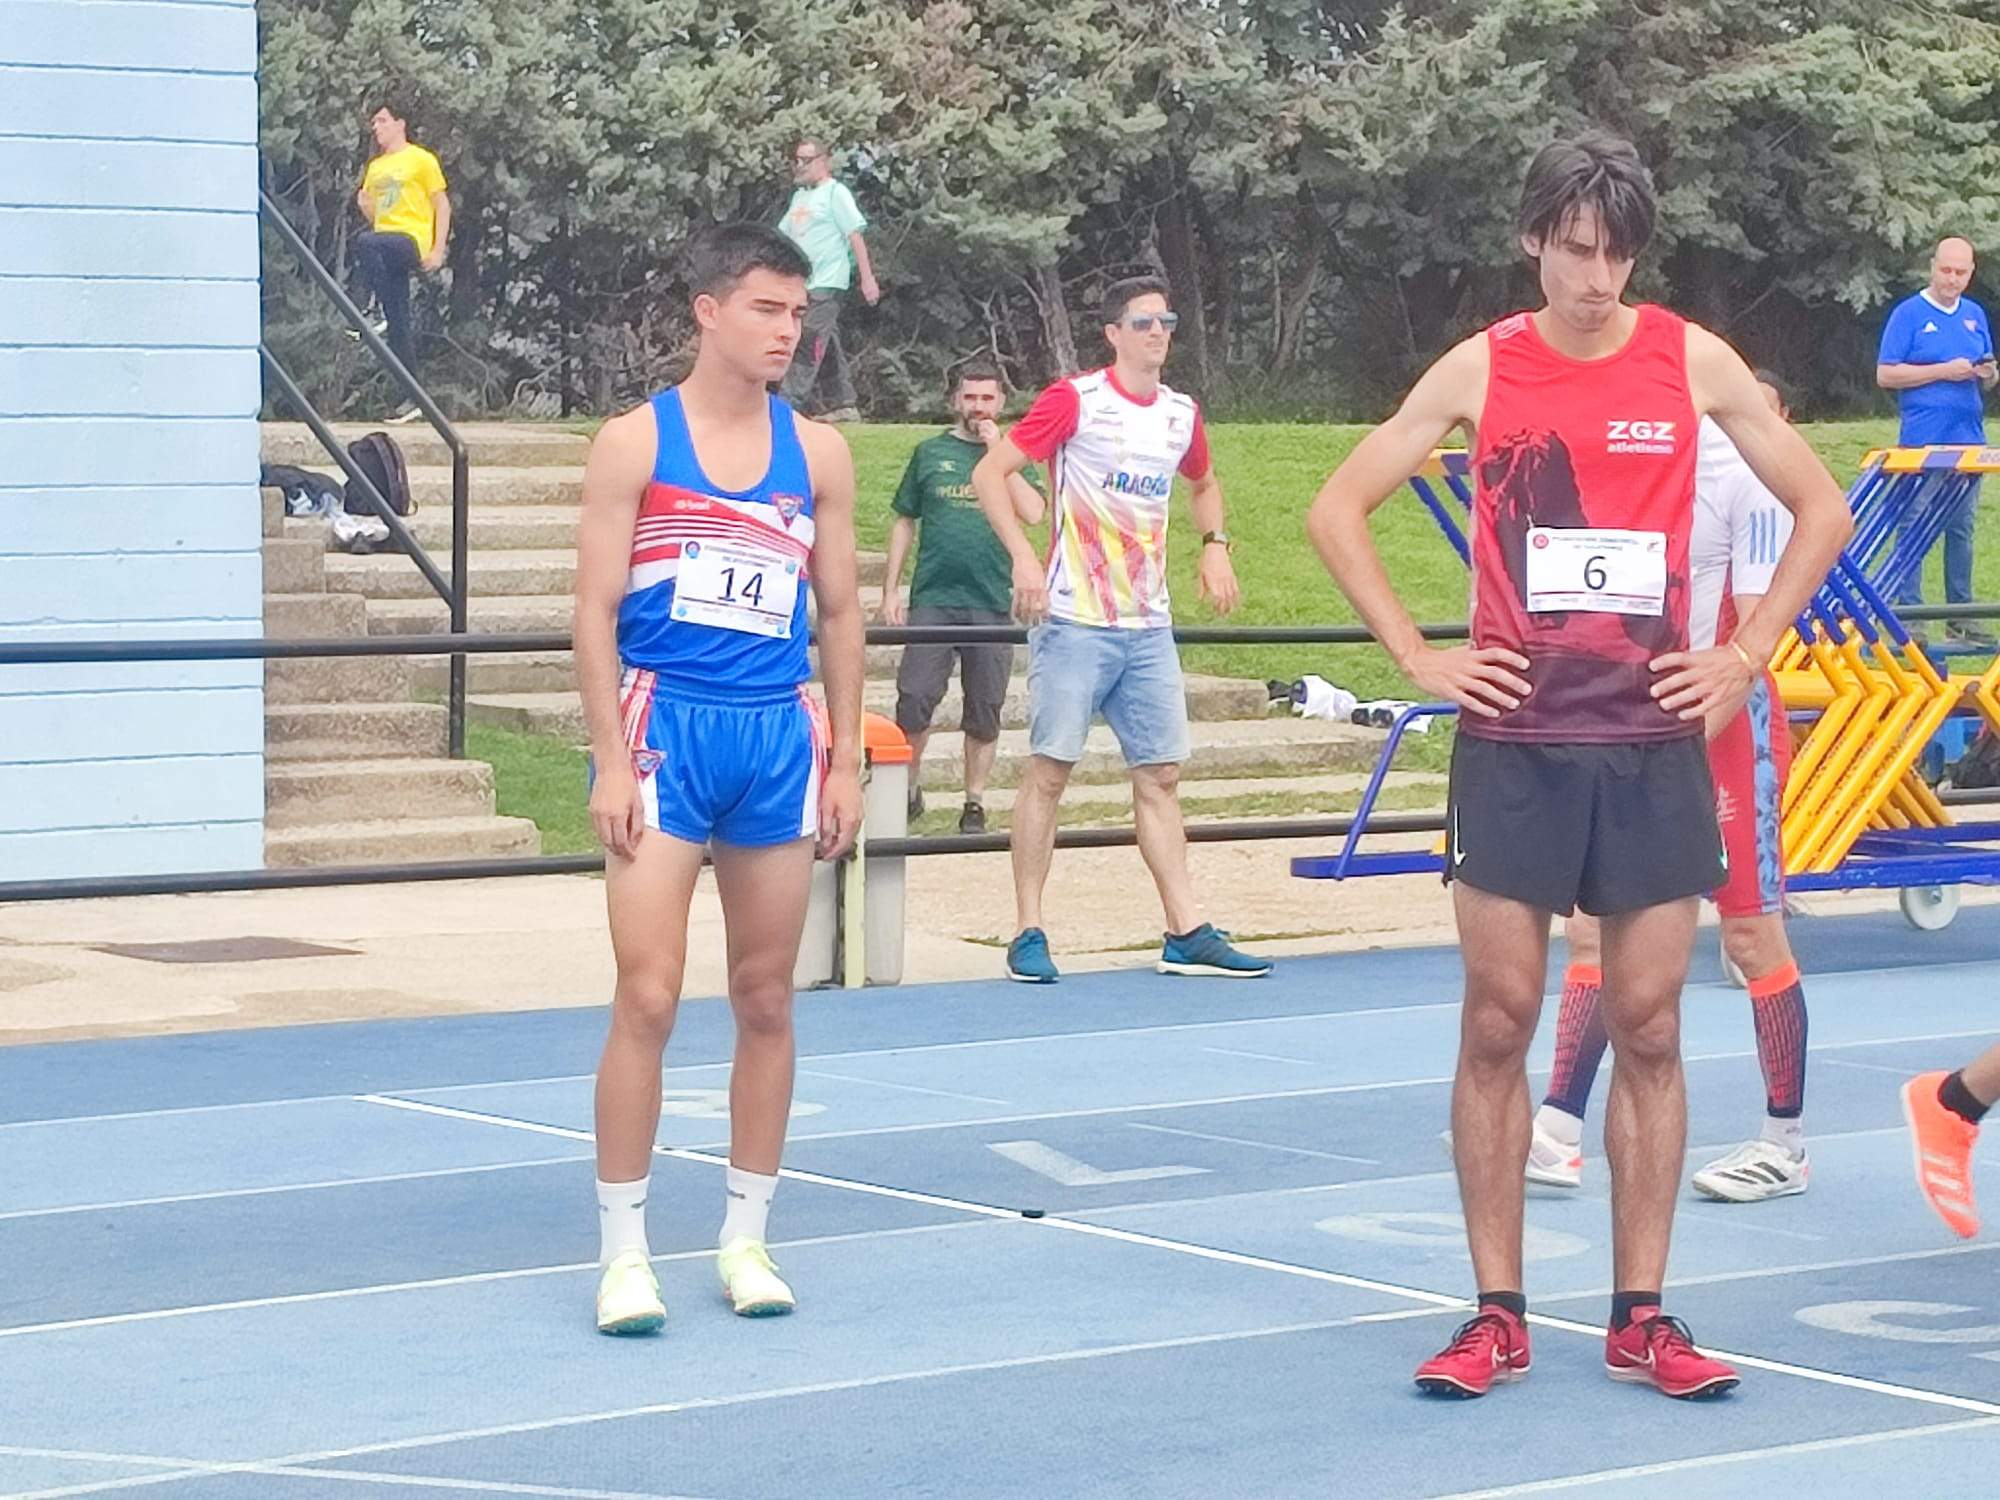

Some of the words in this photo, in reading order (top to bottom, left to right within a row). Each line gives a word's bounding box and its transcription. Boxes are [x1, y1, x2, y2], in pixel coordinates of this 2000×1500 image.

[1607, 420, 1676, 441] ZGZ
[717, 567, 763, 606] 14
[1584, 555, 1607, 590] 6
